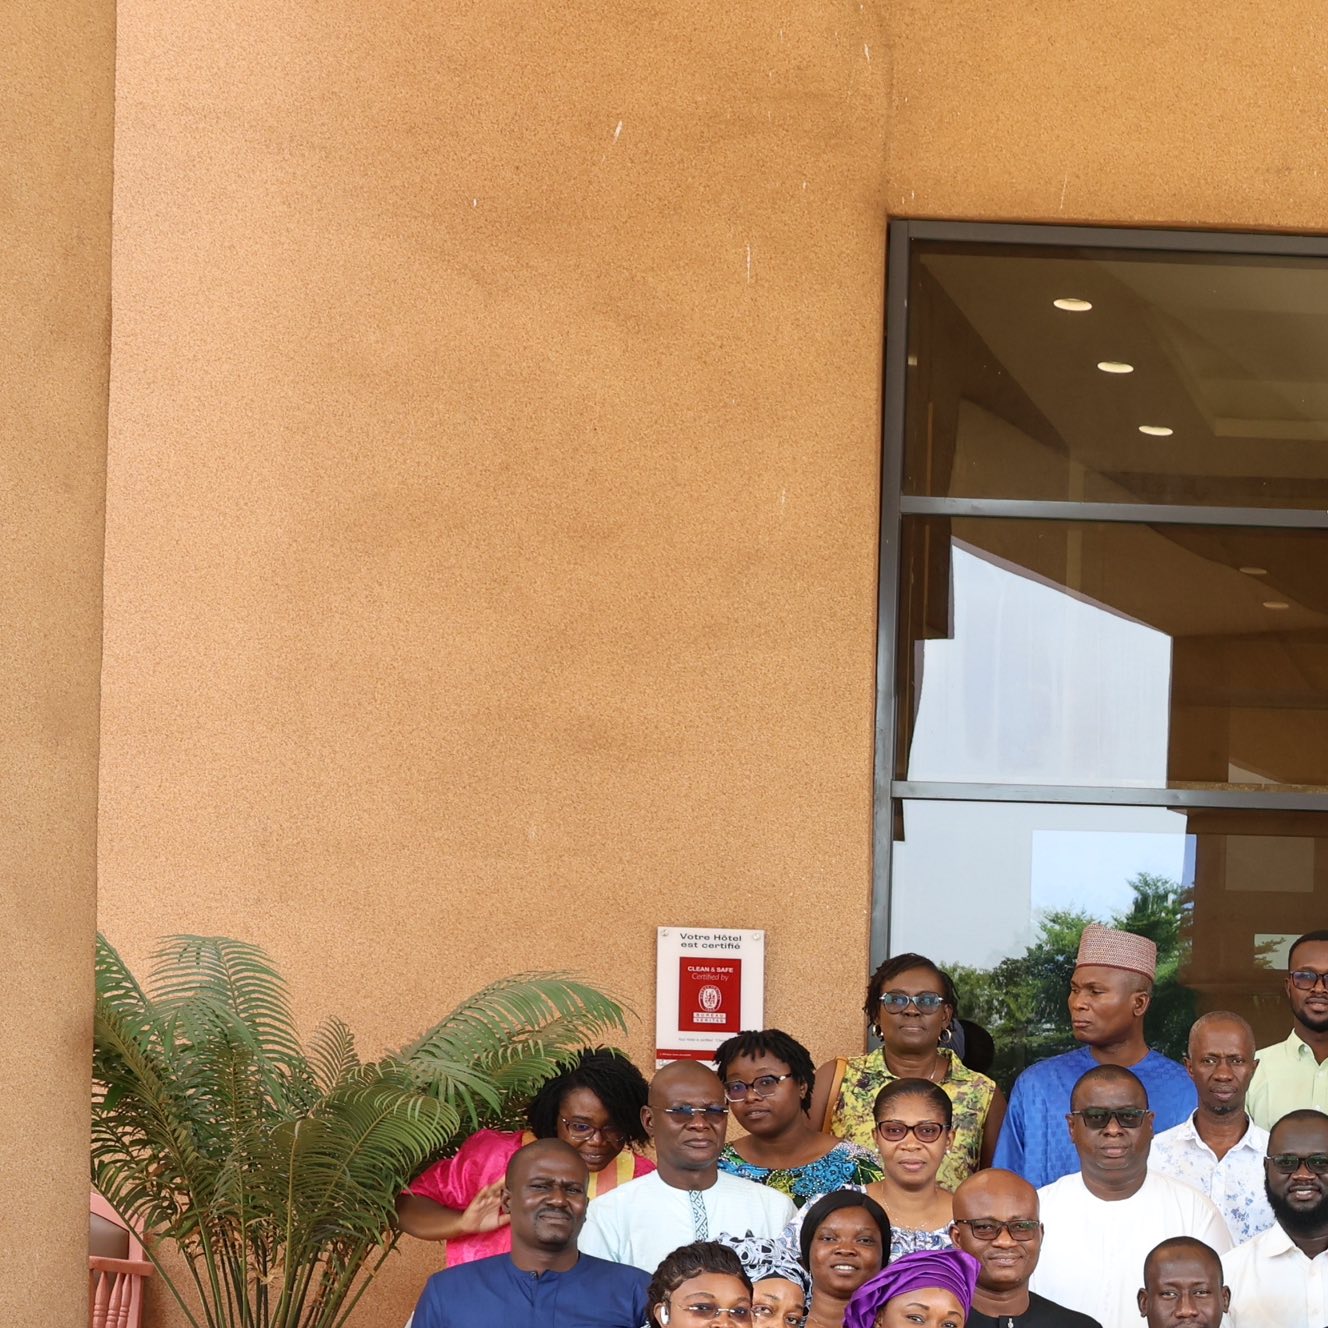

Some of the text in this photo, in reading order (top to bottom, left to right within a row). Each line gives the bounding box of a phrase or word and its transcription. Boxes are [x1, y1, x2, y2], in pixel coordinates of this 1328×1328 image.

[680, 933, 742, 942] Votre Hôtel
[701, 942, 741, 950] certifié
[691, 972, 729, 982] Certified by
